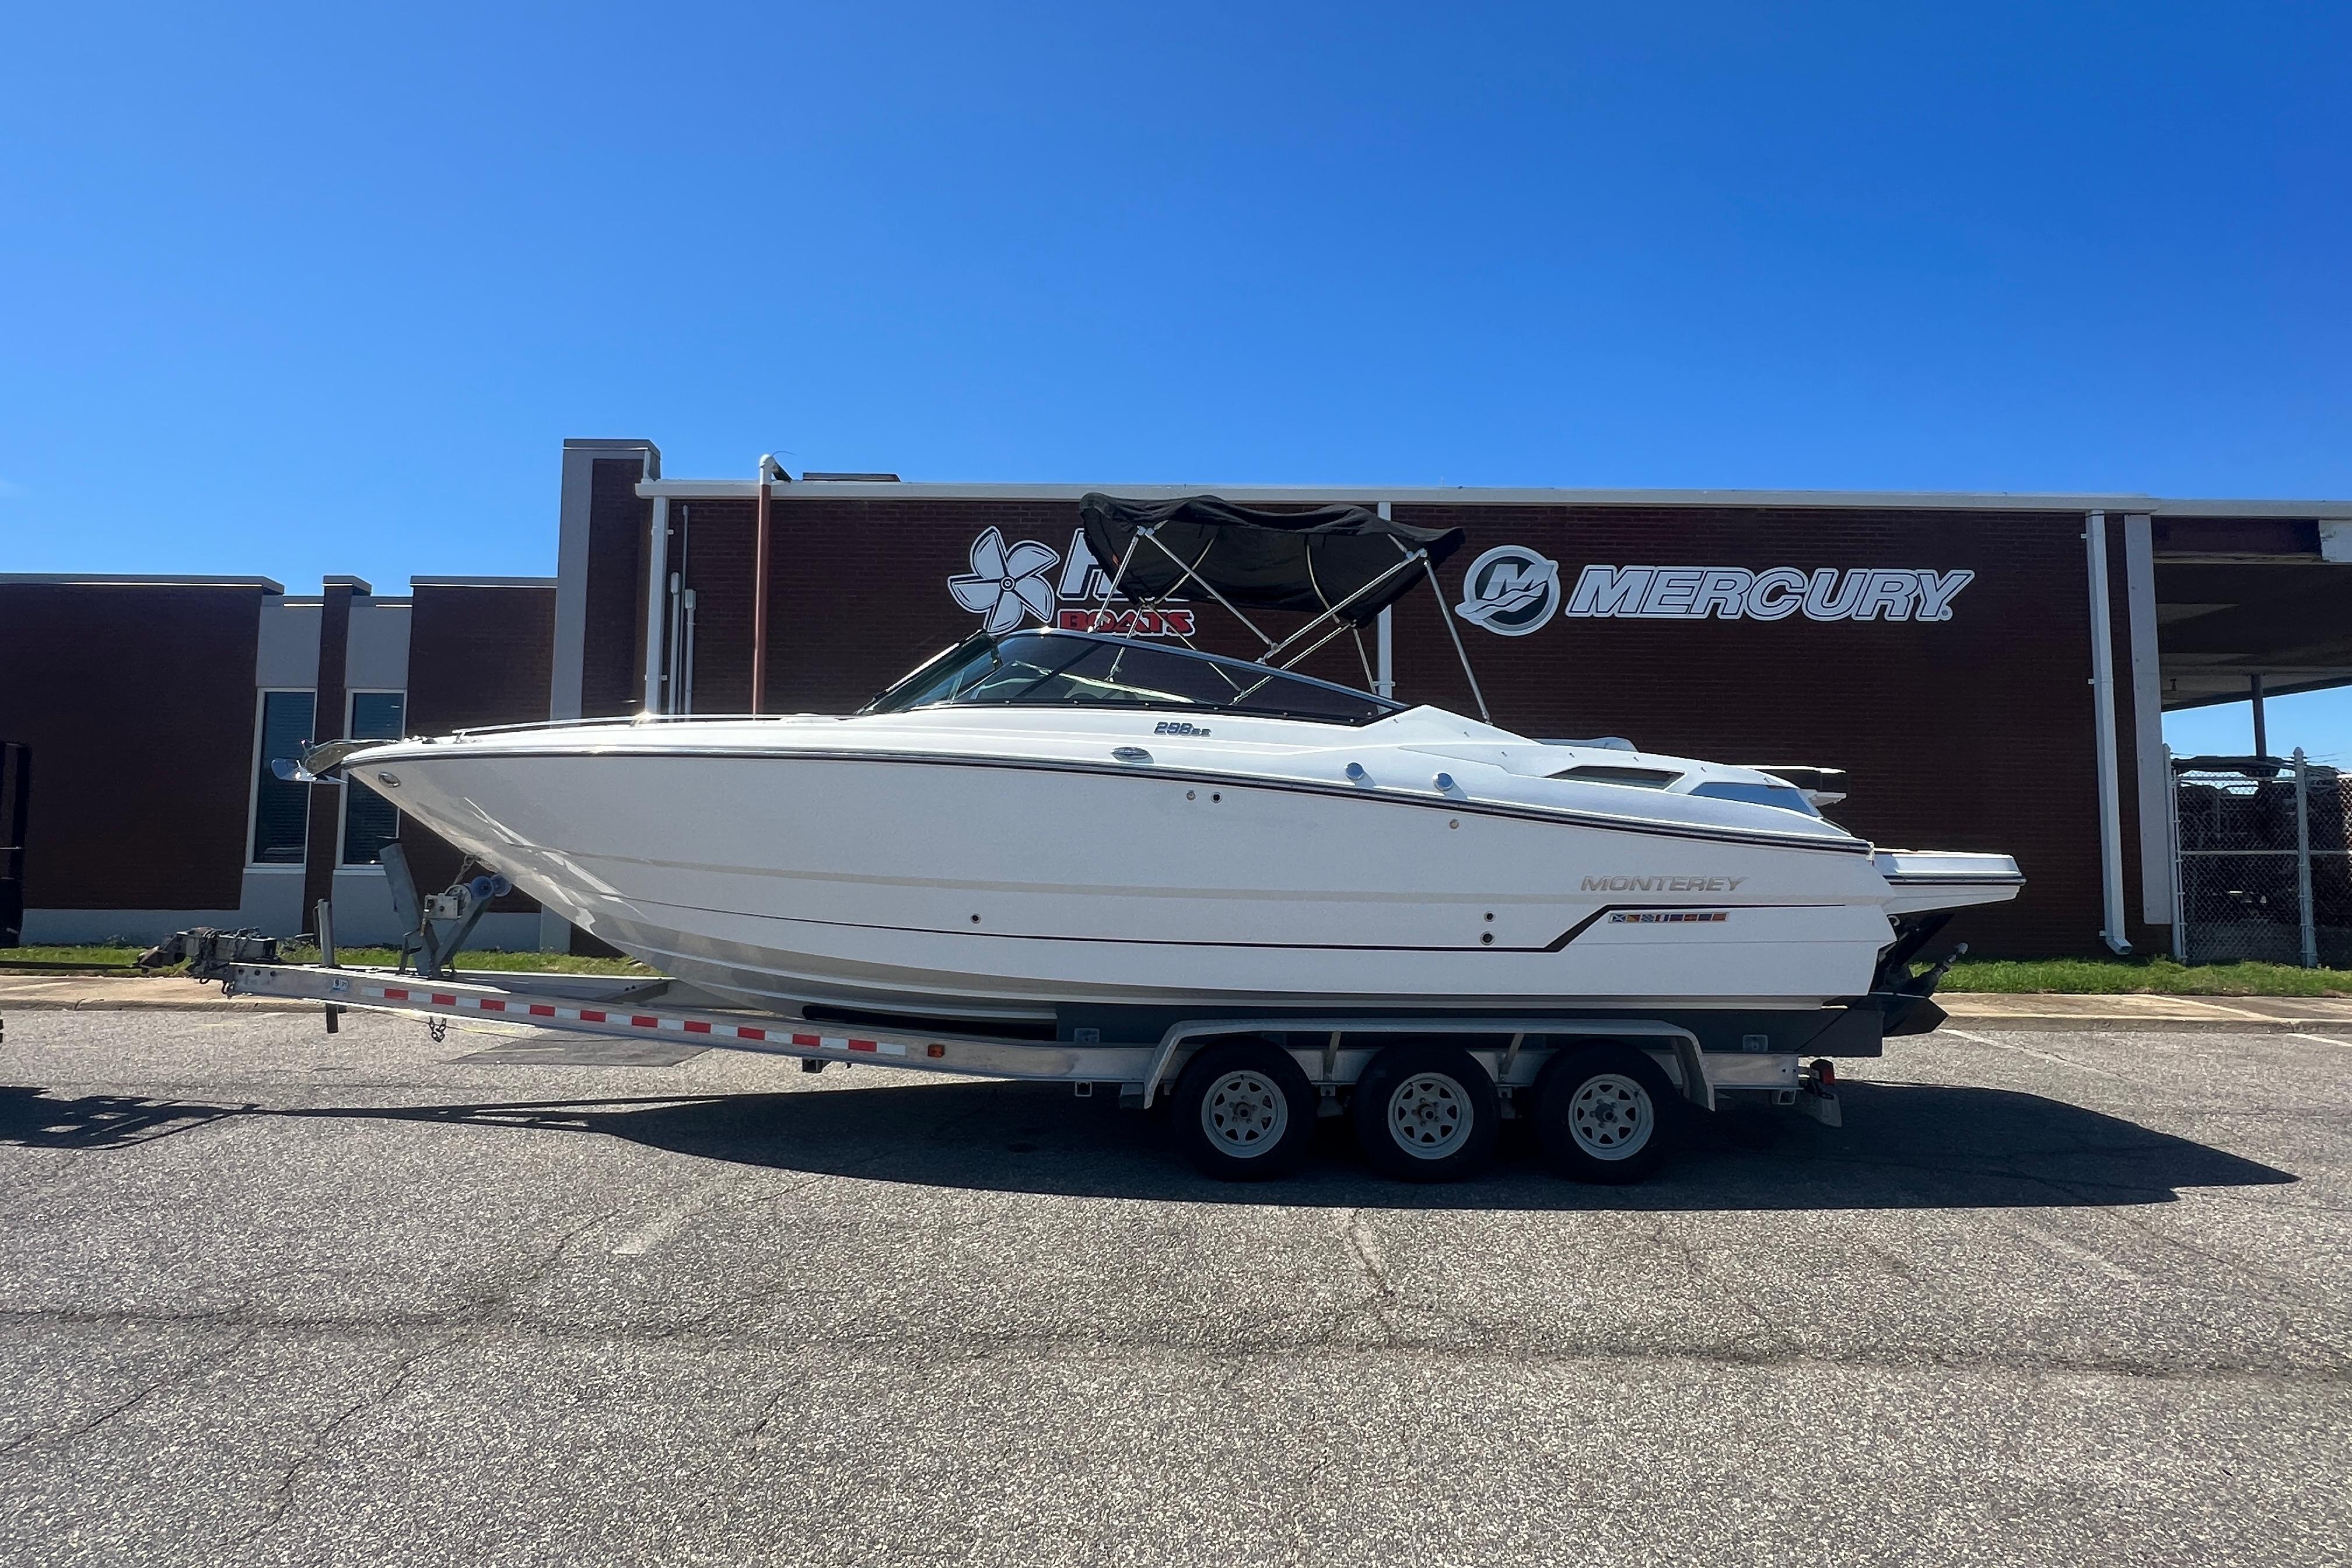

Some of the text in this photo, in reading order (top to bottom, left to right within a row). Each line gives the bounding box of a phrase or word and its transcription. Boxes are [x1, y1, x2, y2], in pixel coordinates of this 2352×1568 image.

[1567, 566, 1974, 621] MERCURY
[1059, 609, 1195, 636] BOATS
[1580, 876, 1749, 891] MONTEREY
